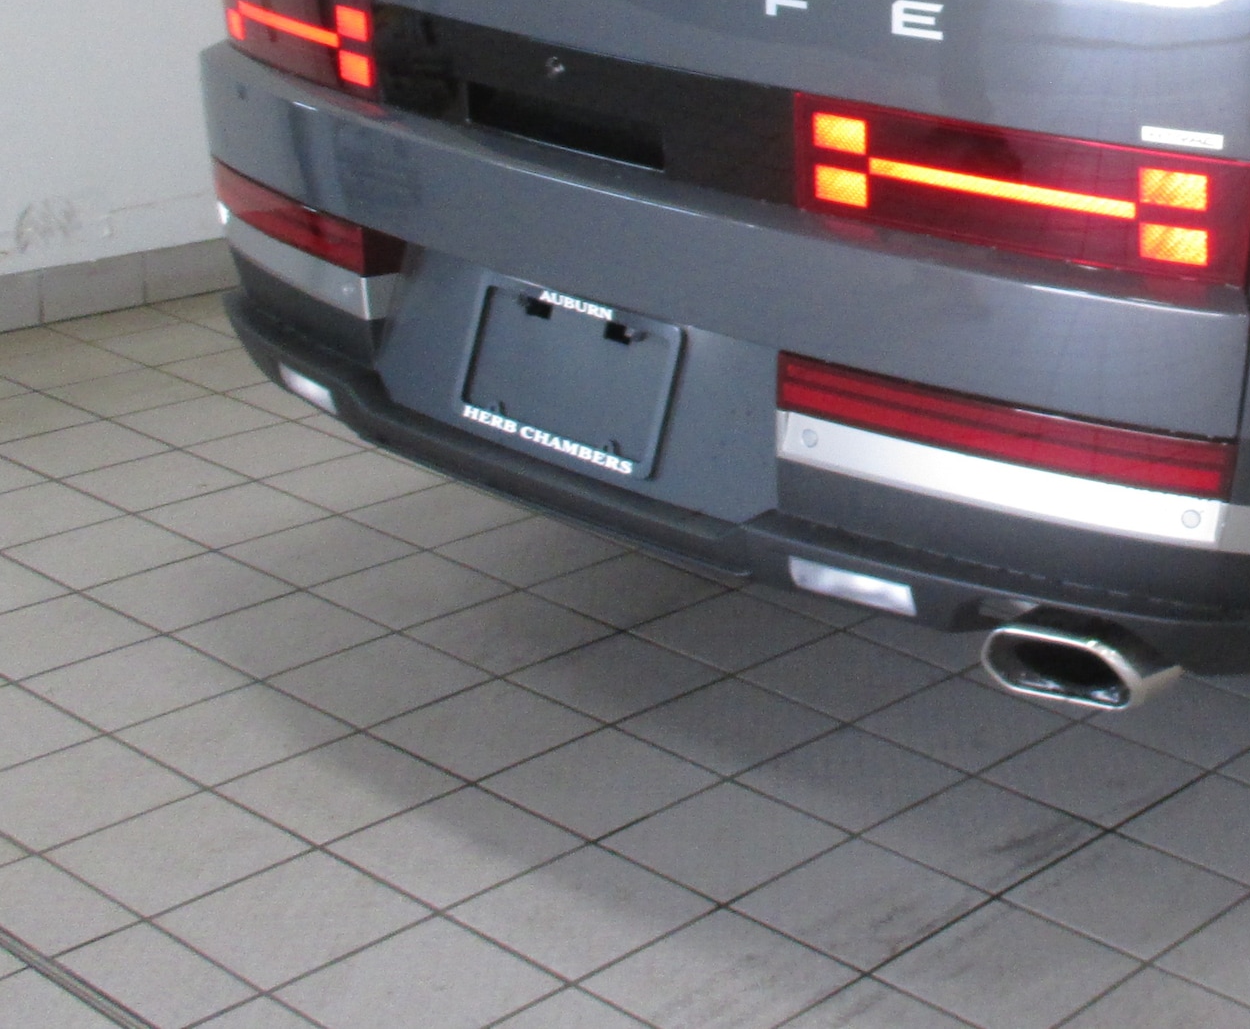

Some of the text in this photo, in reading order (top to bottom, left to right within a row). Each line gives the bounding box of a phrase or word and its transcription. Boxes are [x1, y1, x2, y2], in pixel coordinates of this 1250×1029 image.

[539, 290, 613, 321] AUBURN
[462, 404, 633, 475] HERB CHAMBERS
